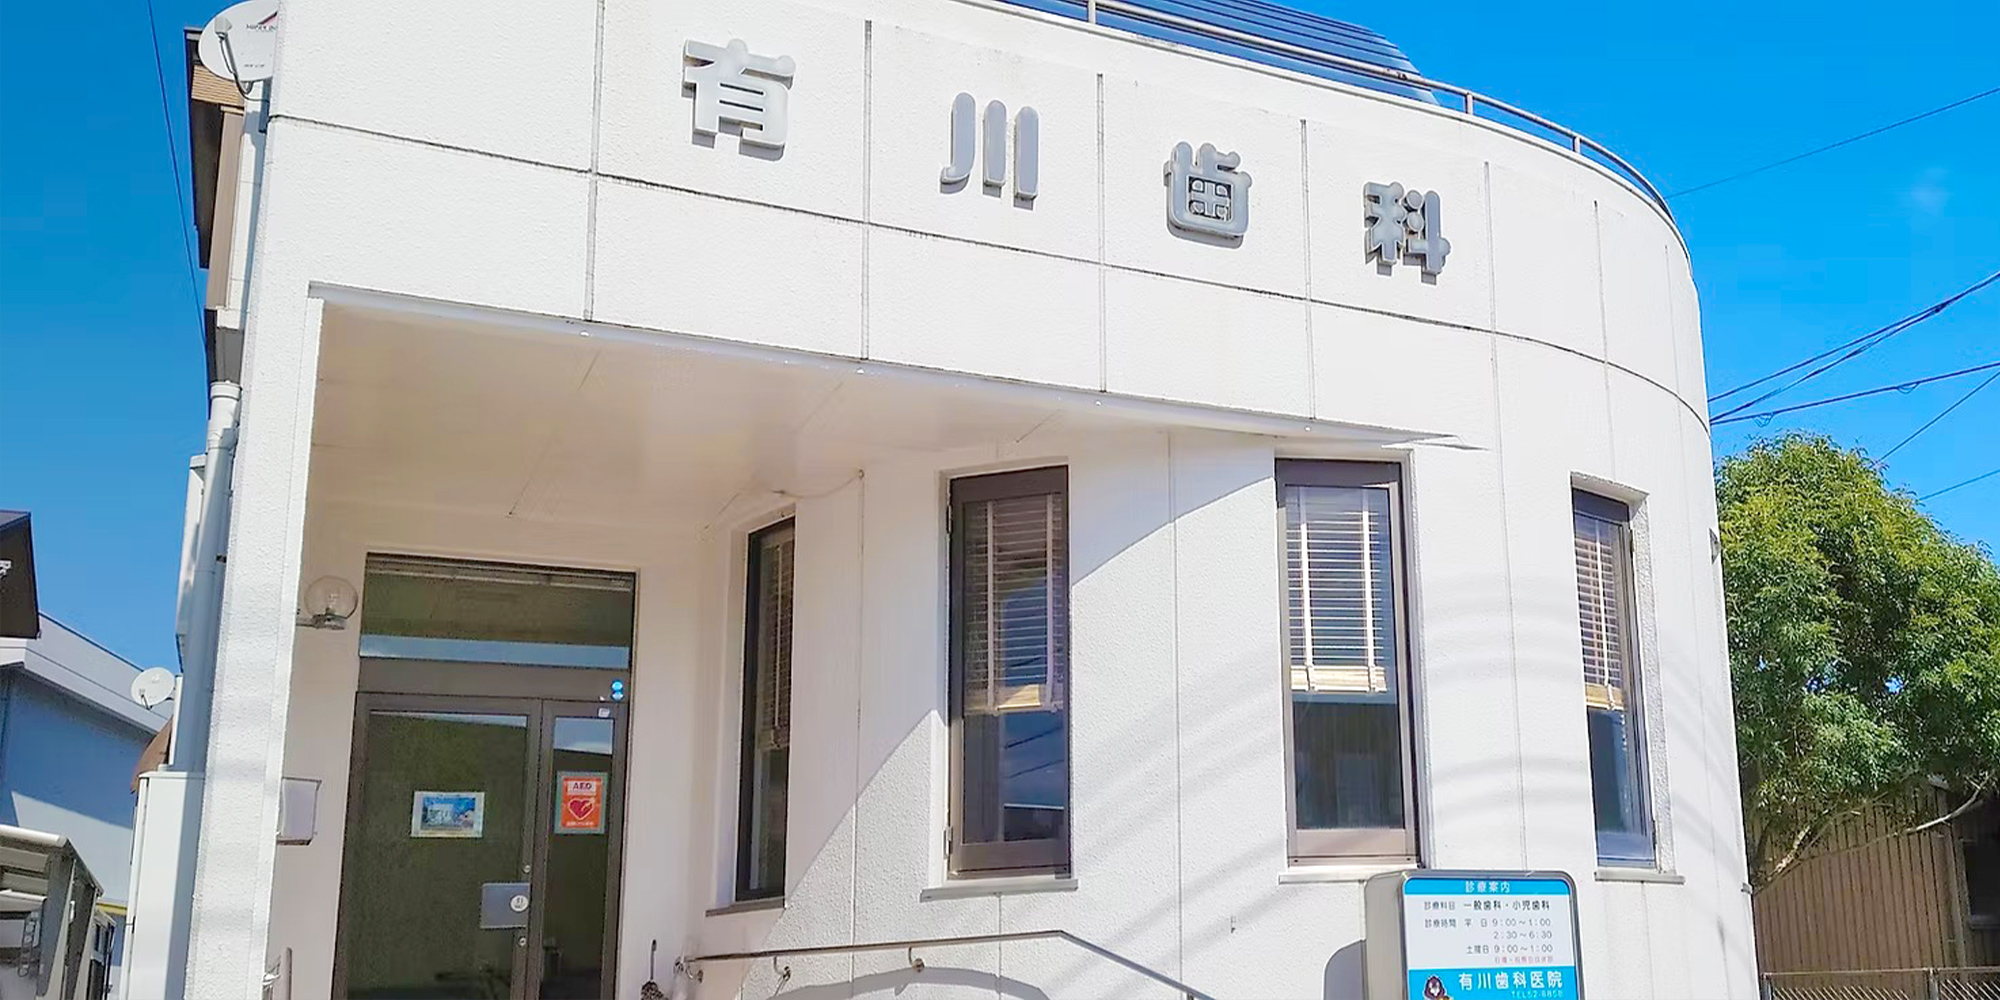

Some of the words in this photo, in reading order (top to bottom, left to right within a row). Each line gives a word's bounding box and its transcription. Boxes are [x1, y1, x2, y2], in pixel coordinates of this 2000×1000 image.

[683, 37, 1450, 277] 有川歯科
[1465, 880, 1511, 893] 診療案内
[1464, 900, 1550, 911] 一般歯科・小児歯科
[1424, 918, 1457, 928] 診療時間
[1458, 971, 1563, 991] 有川歯科医院
